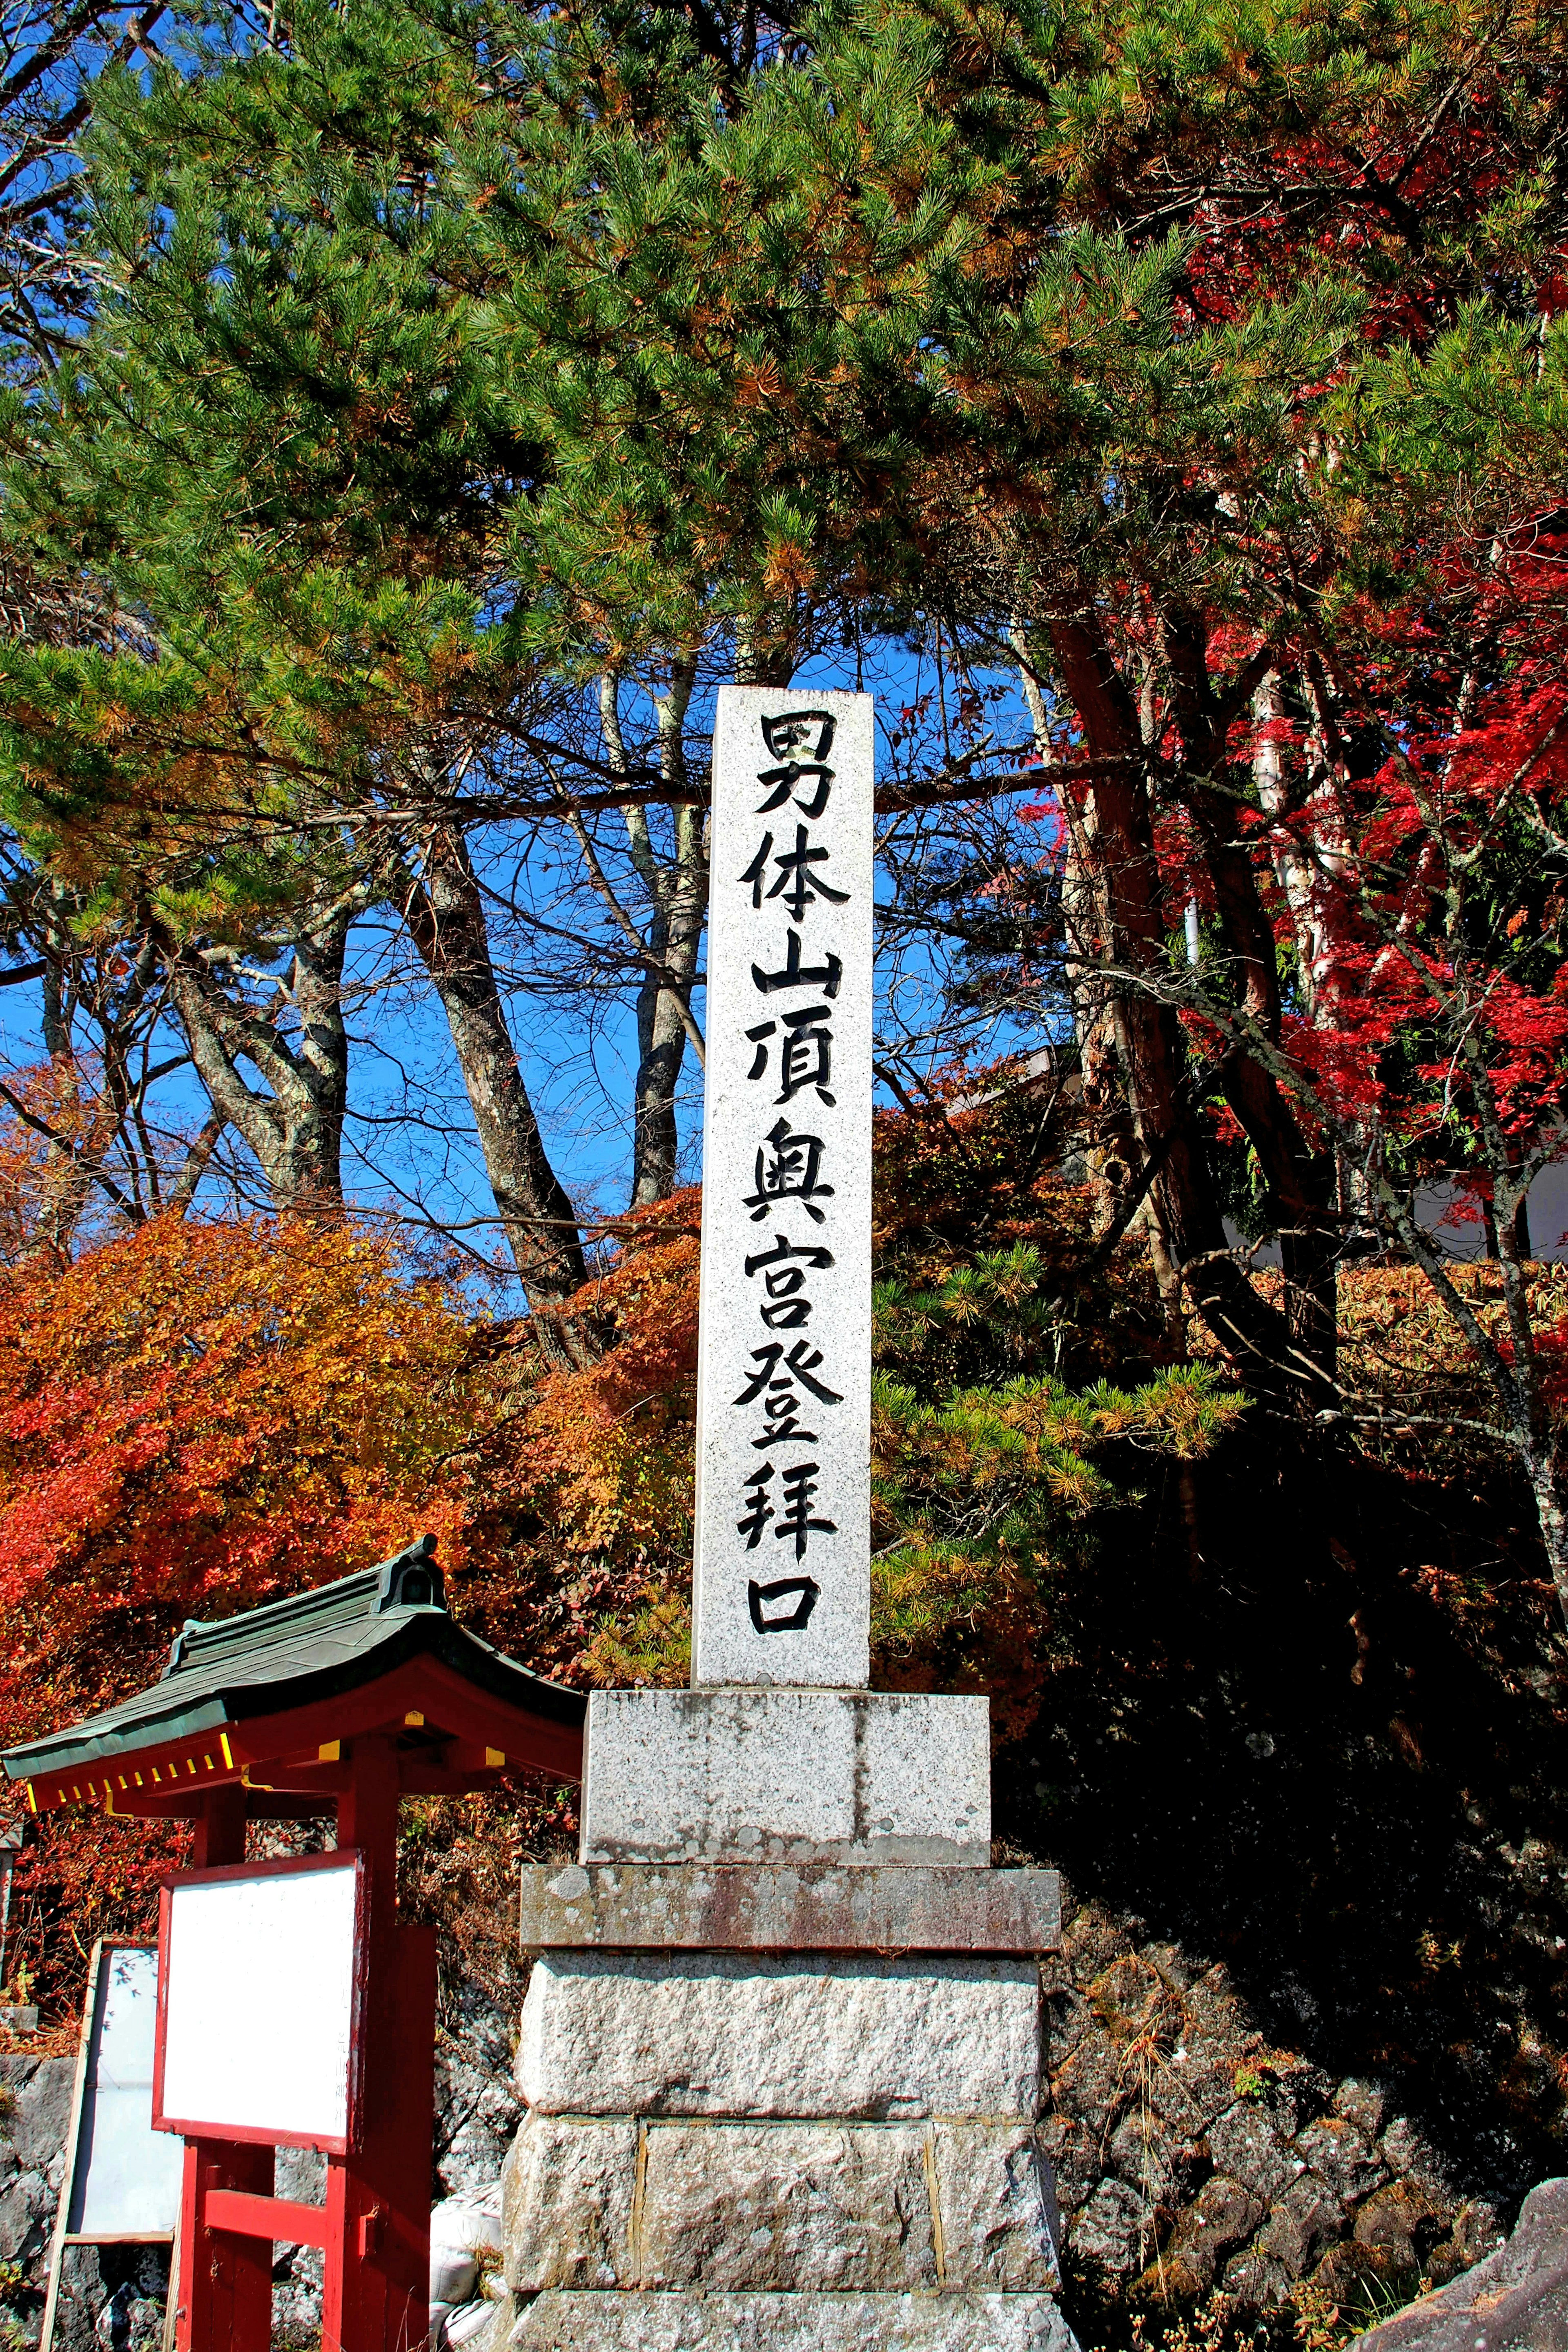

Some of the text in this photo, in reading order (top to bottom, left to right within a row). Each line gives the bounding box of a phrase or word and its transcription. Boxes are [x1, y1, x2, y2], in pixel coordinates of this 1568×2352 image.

[731, 710, 851, 1635] 男体山頂奥宮登拝口
